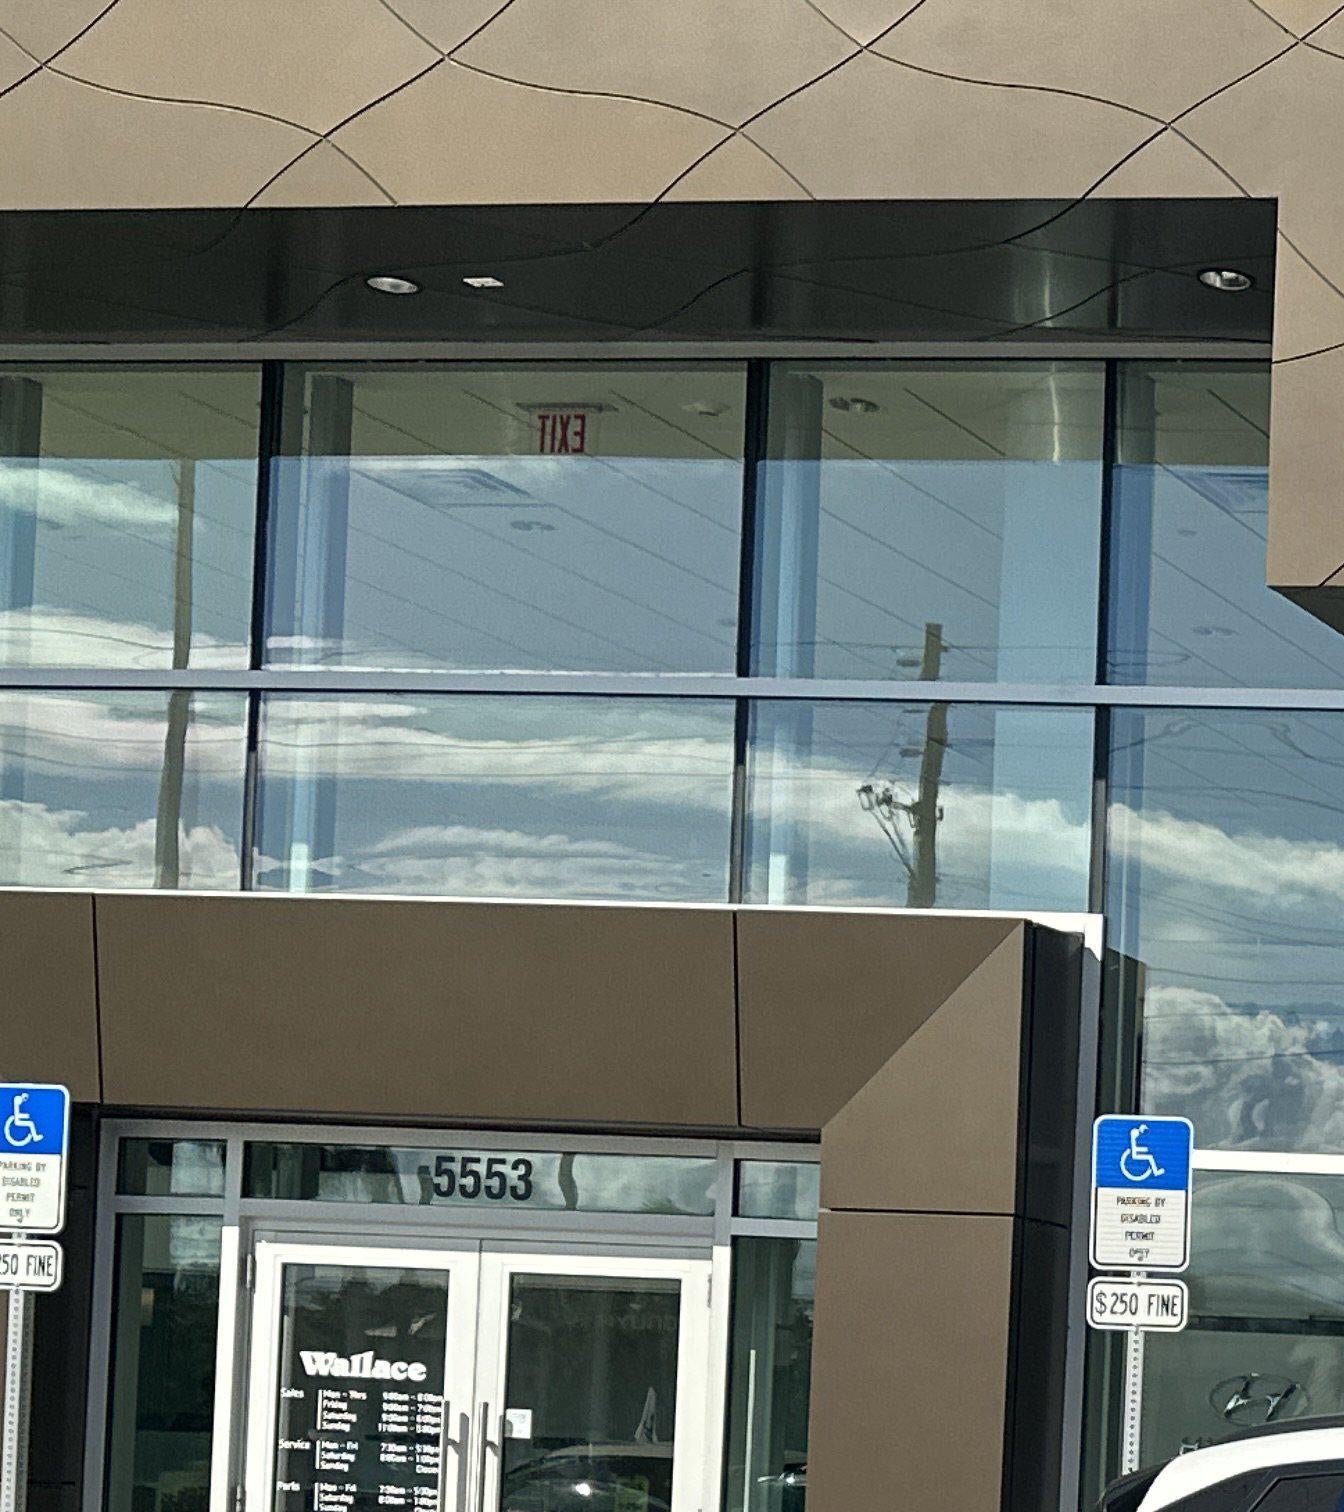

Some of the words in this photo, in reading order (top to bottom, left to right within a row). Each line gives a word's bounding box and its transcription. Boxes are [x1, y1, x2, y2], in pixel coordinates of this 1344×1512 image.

[433, 1155, 532, 1201] 5553
[1116, 1196, 1151, 1207] PARKING
[1154, 1197, 1166, 1207] BY
[1120, 1213, 1161, 1224] DISABLED
[1125, 1231, 1154, 1241] PERMIT
[26, 1254, 54, 1277] FINE
[1095, 1290, 1138, 1317] $250
[1147, 1294, 1179, 1317] FINE
[299, 1350, 428, 1382] Wallace
[279, 1438, 311, 1450] Service
